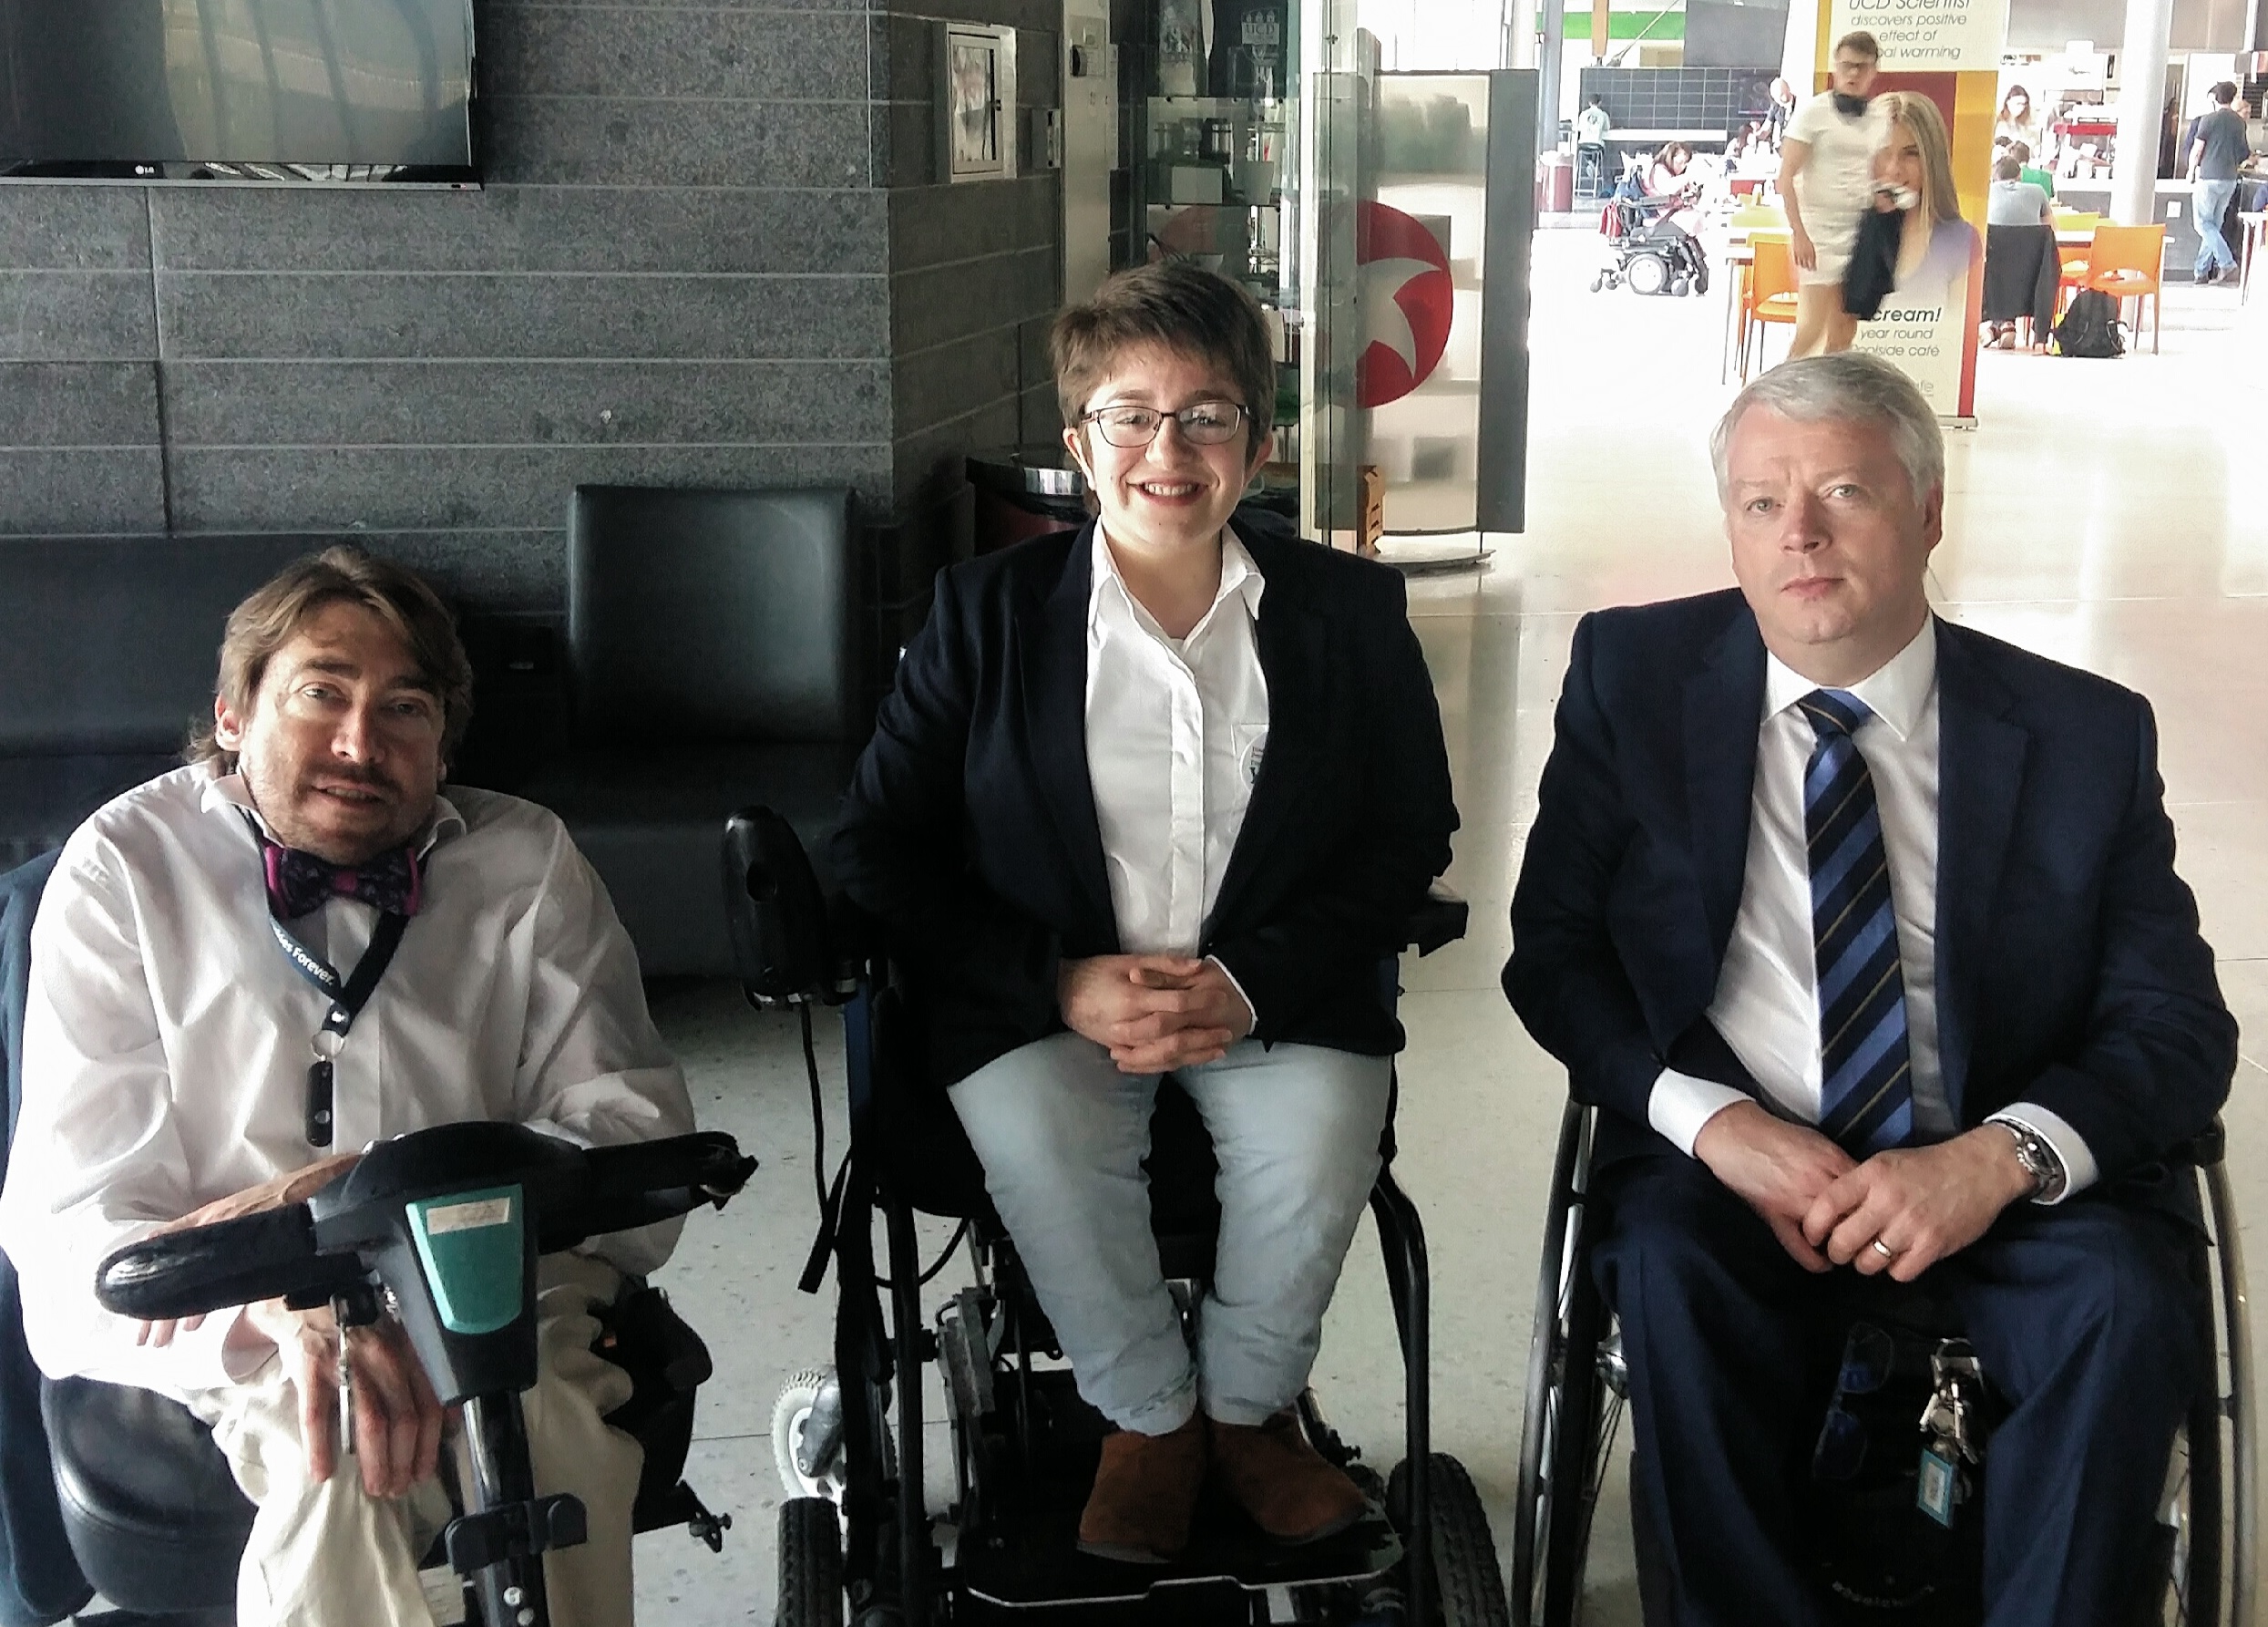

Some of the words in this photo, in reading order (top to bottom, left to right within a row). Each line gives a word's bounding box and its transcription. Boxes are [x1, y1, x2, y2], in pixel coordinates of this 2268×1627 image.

[1851, 15, 1913, 26] discovers
[1916, 14, 1967, 27] positive
[1246, 24, 1275, 35] UCD
[1879, 30, 1920, 41] effect
[1923, 29, 1938, 41] of
[1900, 46, 1961, 60] warming
[1860, 329, 1890, 340] year
[1893, 328, 1934, 339] round
[1908, 345, 1940, 357] café
